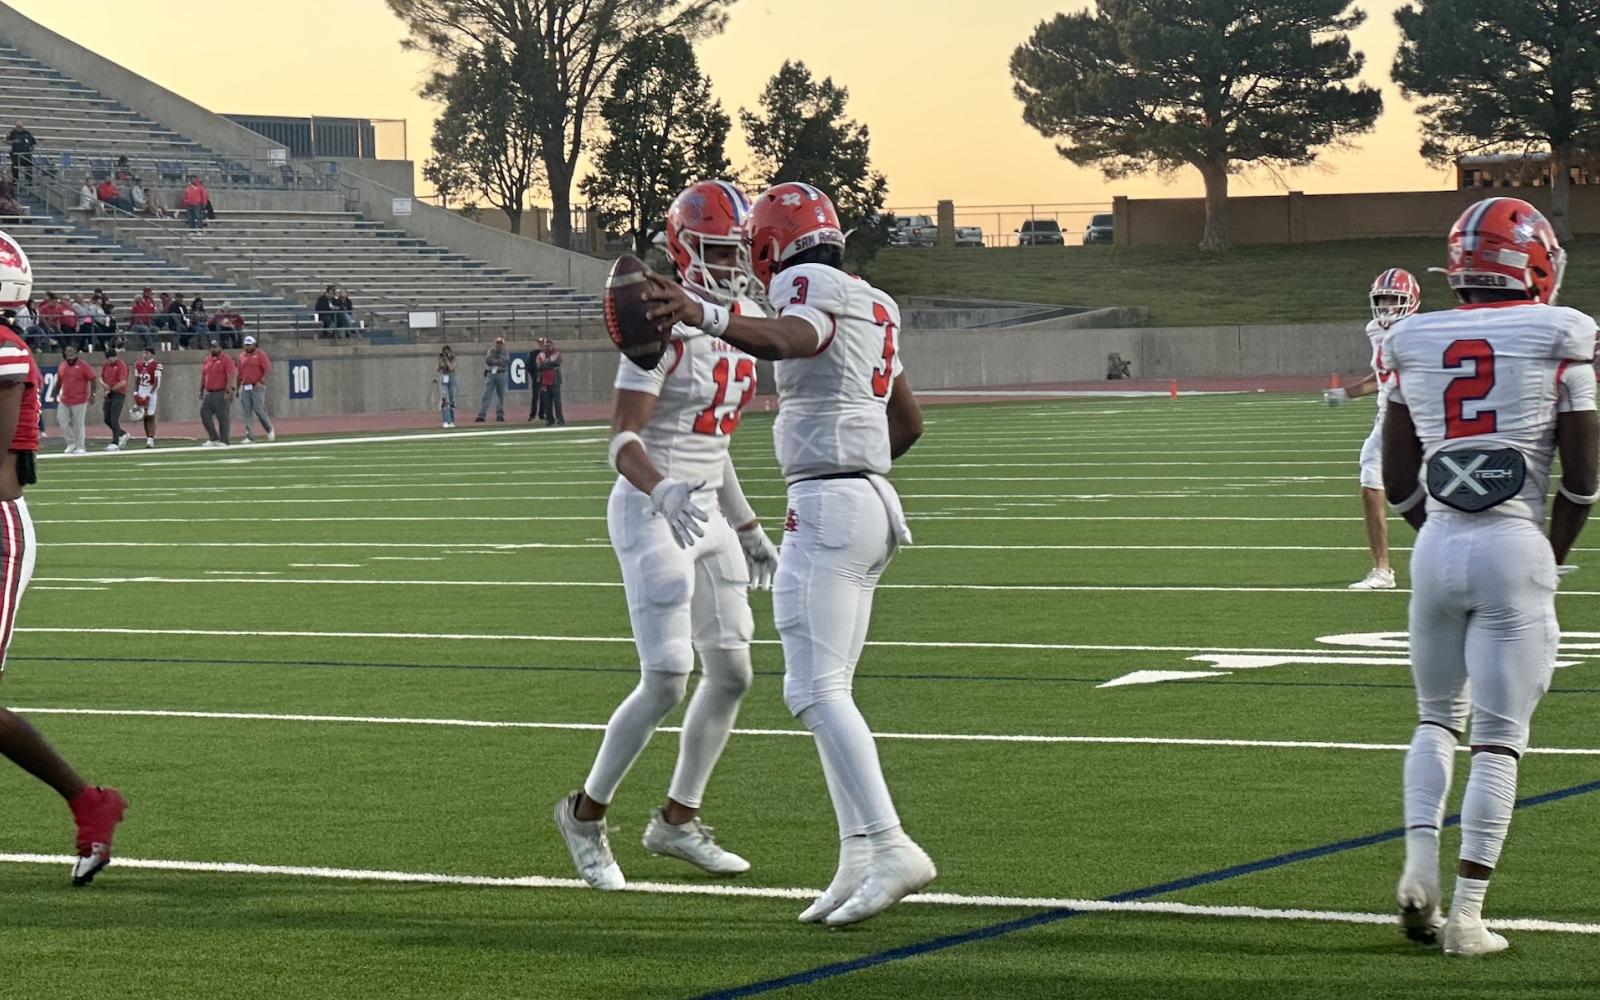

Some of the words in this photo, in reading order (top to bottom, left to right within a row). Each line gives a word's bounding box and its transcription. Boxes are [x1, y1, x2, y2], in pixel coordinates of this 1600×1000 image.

[795, 234, 817, 251] SAN
[789, 276, 809, 305] 3
[871, 302, 895, 398] 3
[292, 365, 310, 394] 10
[510, 357, 526, 385] G
[1442, 338, 1498, 440] 2
